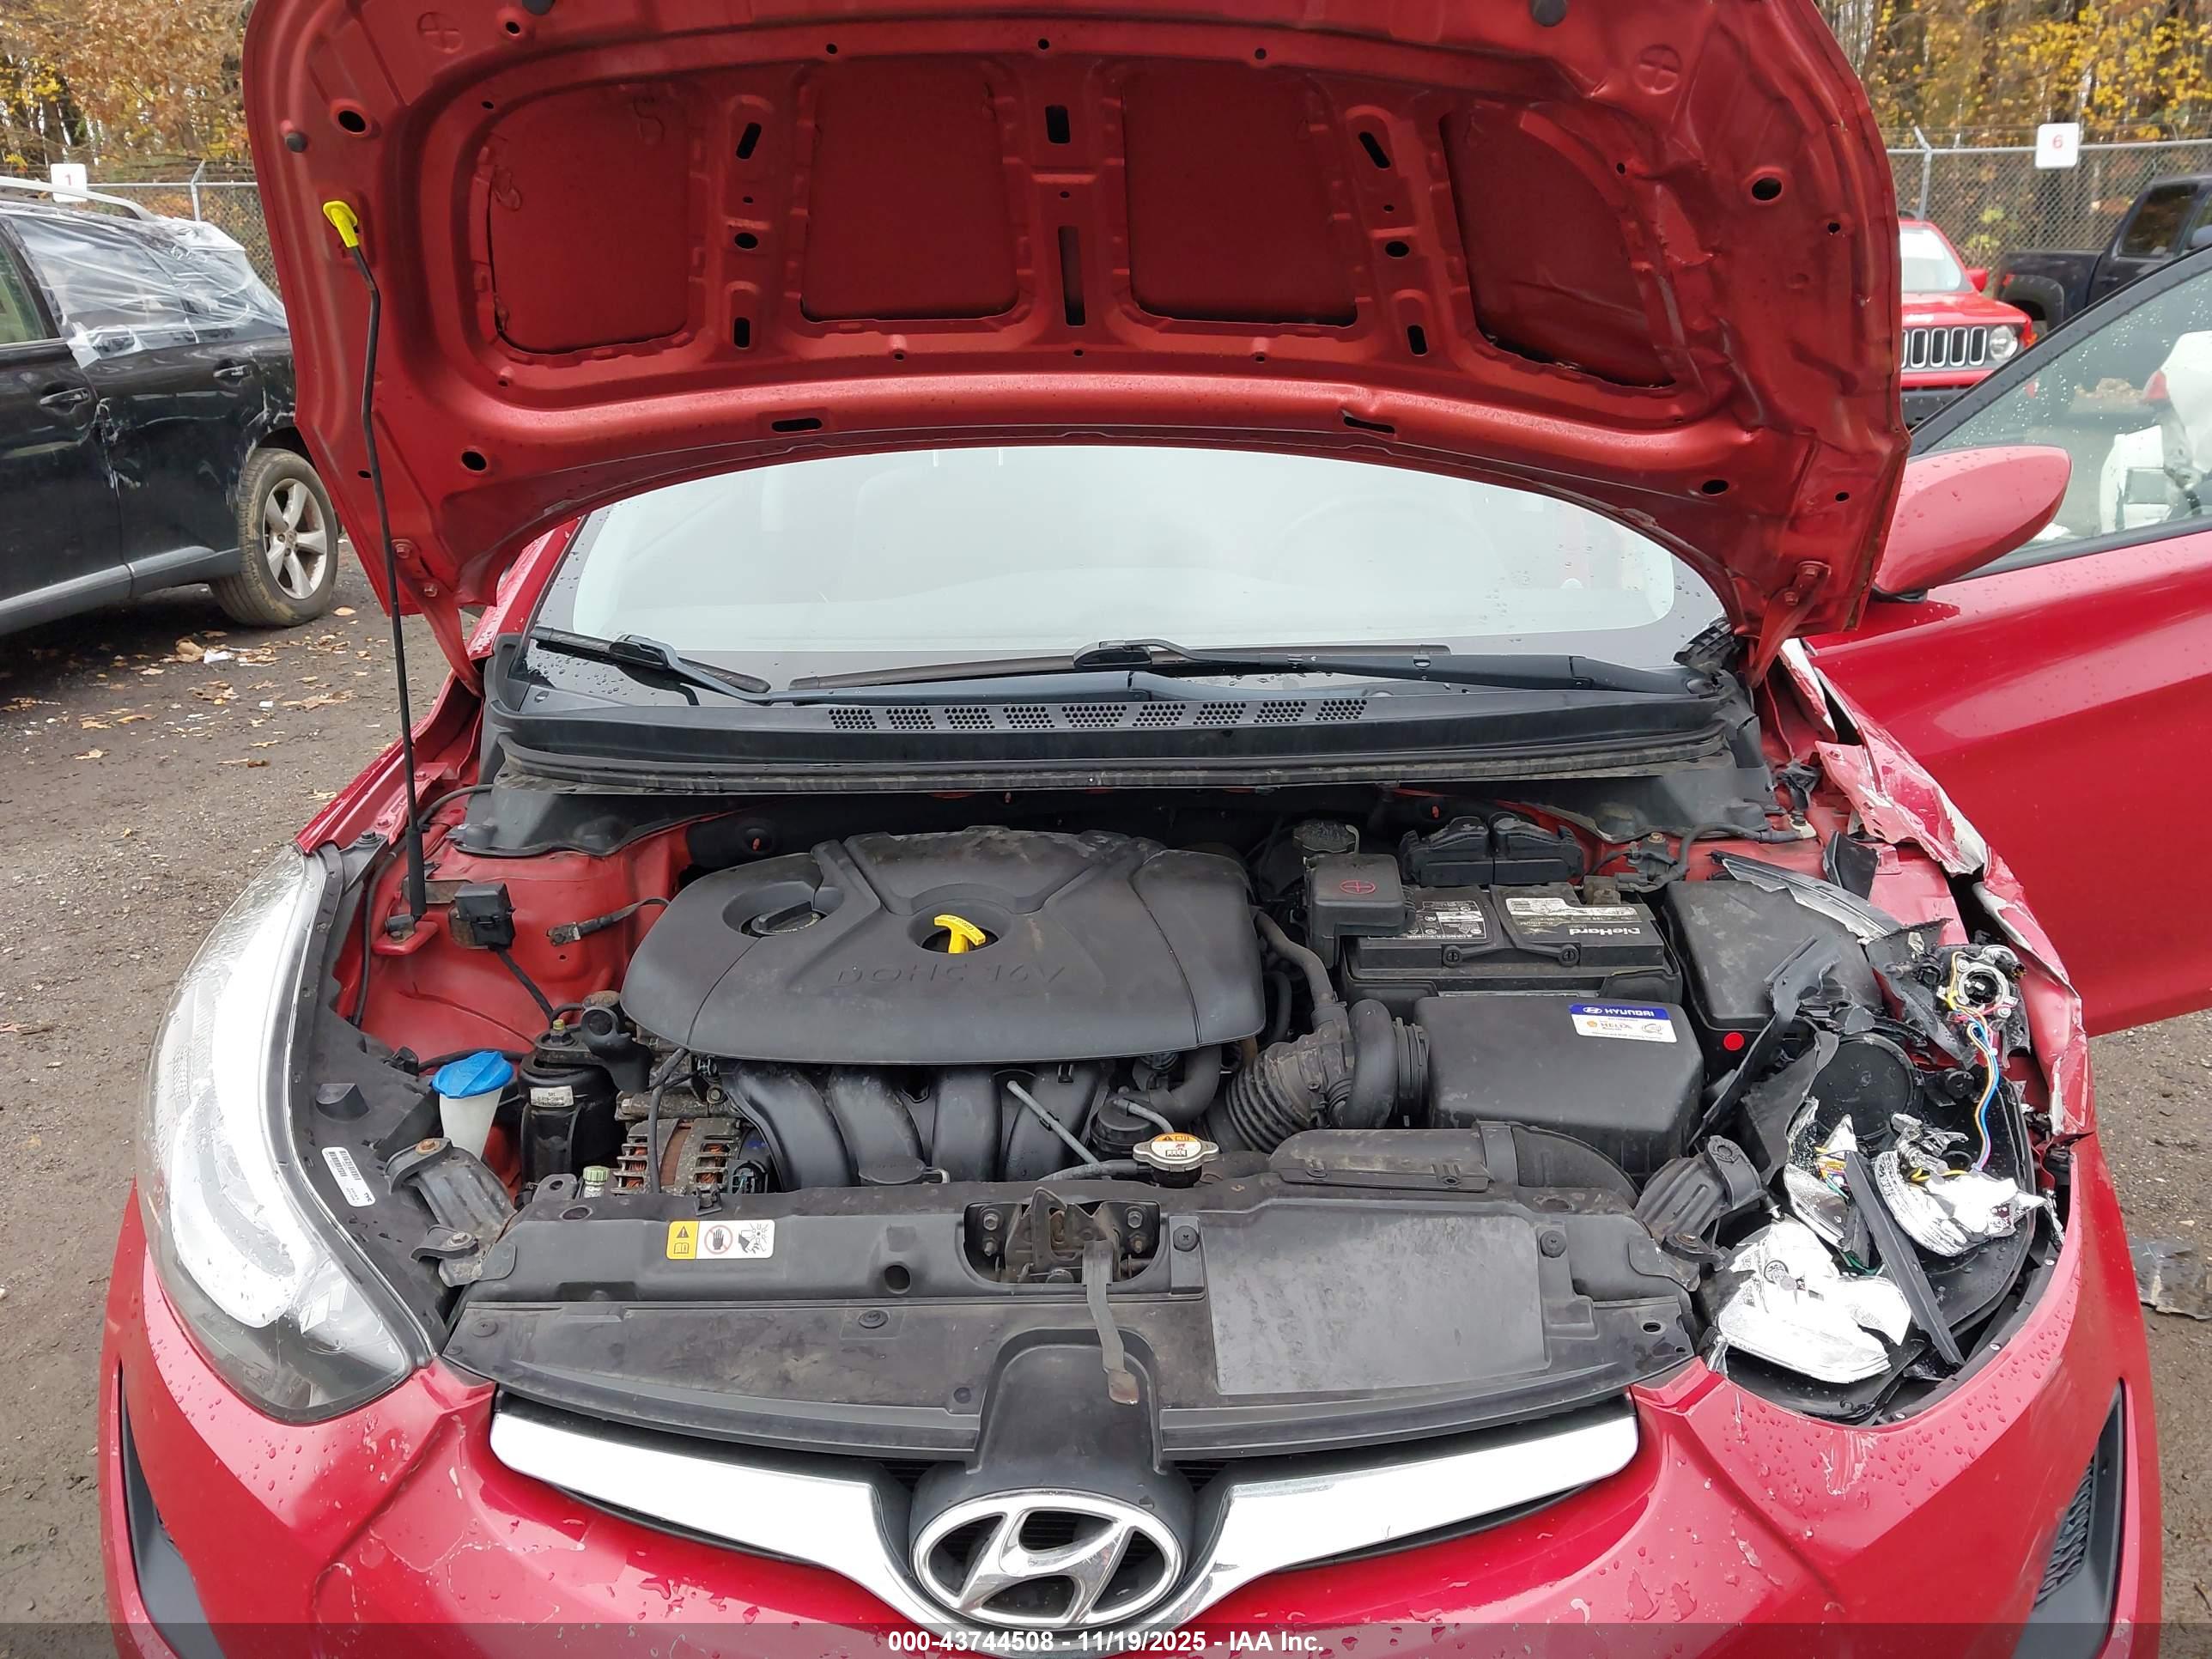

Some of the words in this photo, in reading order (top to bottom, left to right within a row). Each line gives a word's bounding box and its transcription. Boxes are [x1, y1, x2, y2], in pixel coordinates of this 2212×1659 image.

[2053, 134, 2063, 149] 6
[64, 173, 72, 186] 1
[1569, 927, 1641, 936] DieHard
[837, 963, 969, 985] DOHC
[988, 963, 1066, 984] 16V
[1604, 1007, 1656, 1018] HYUNDAI
